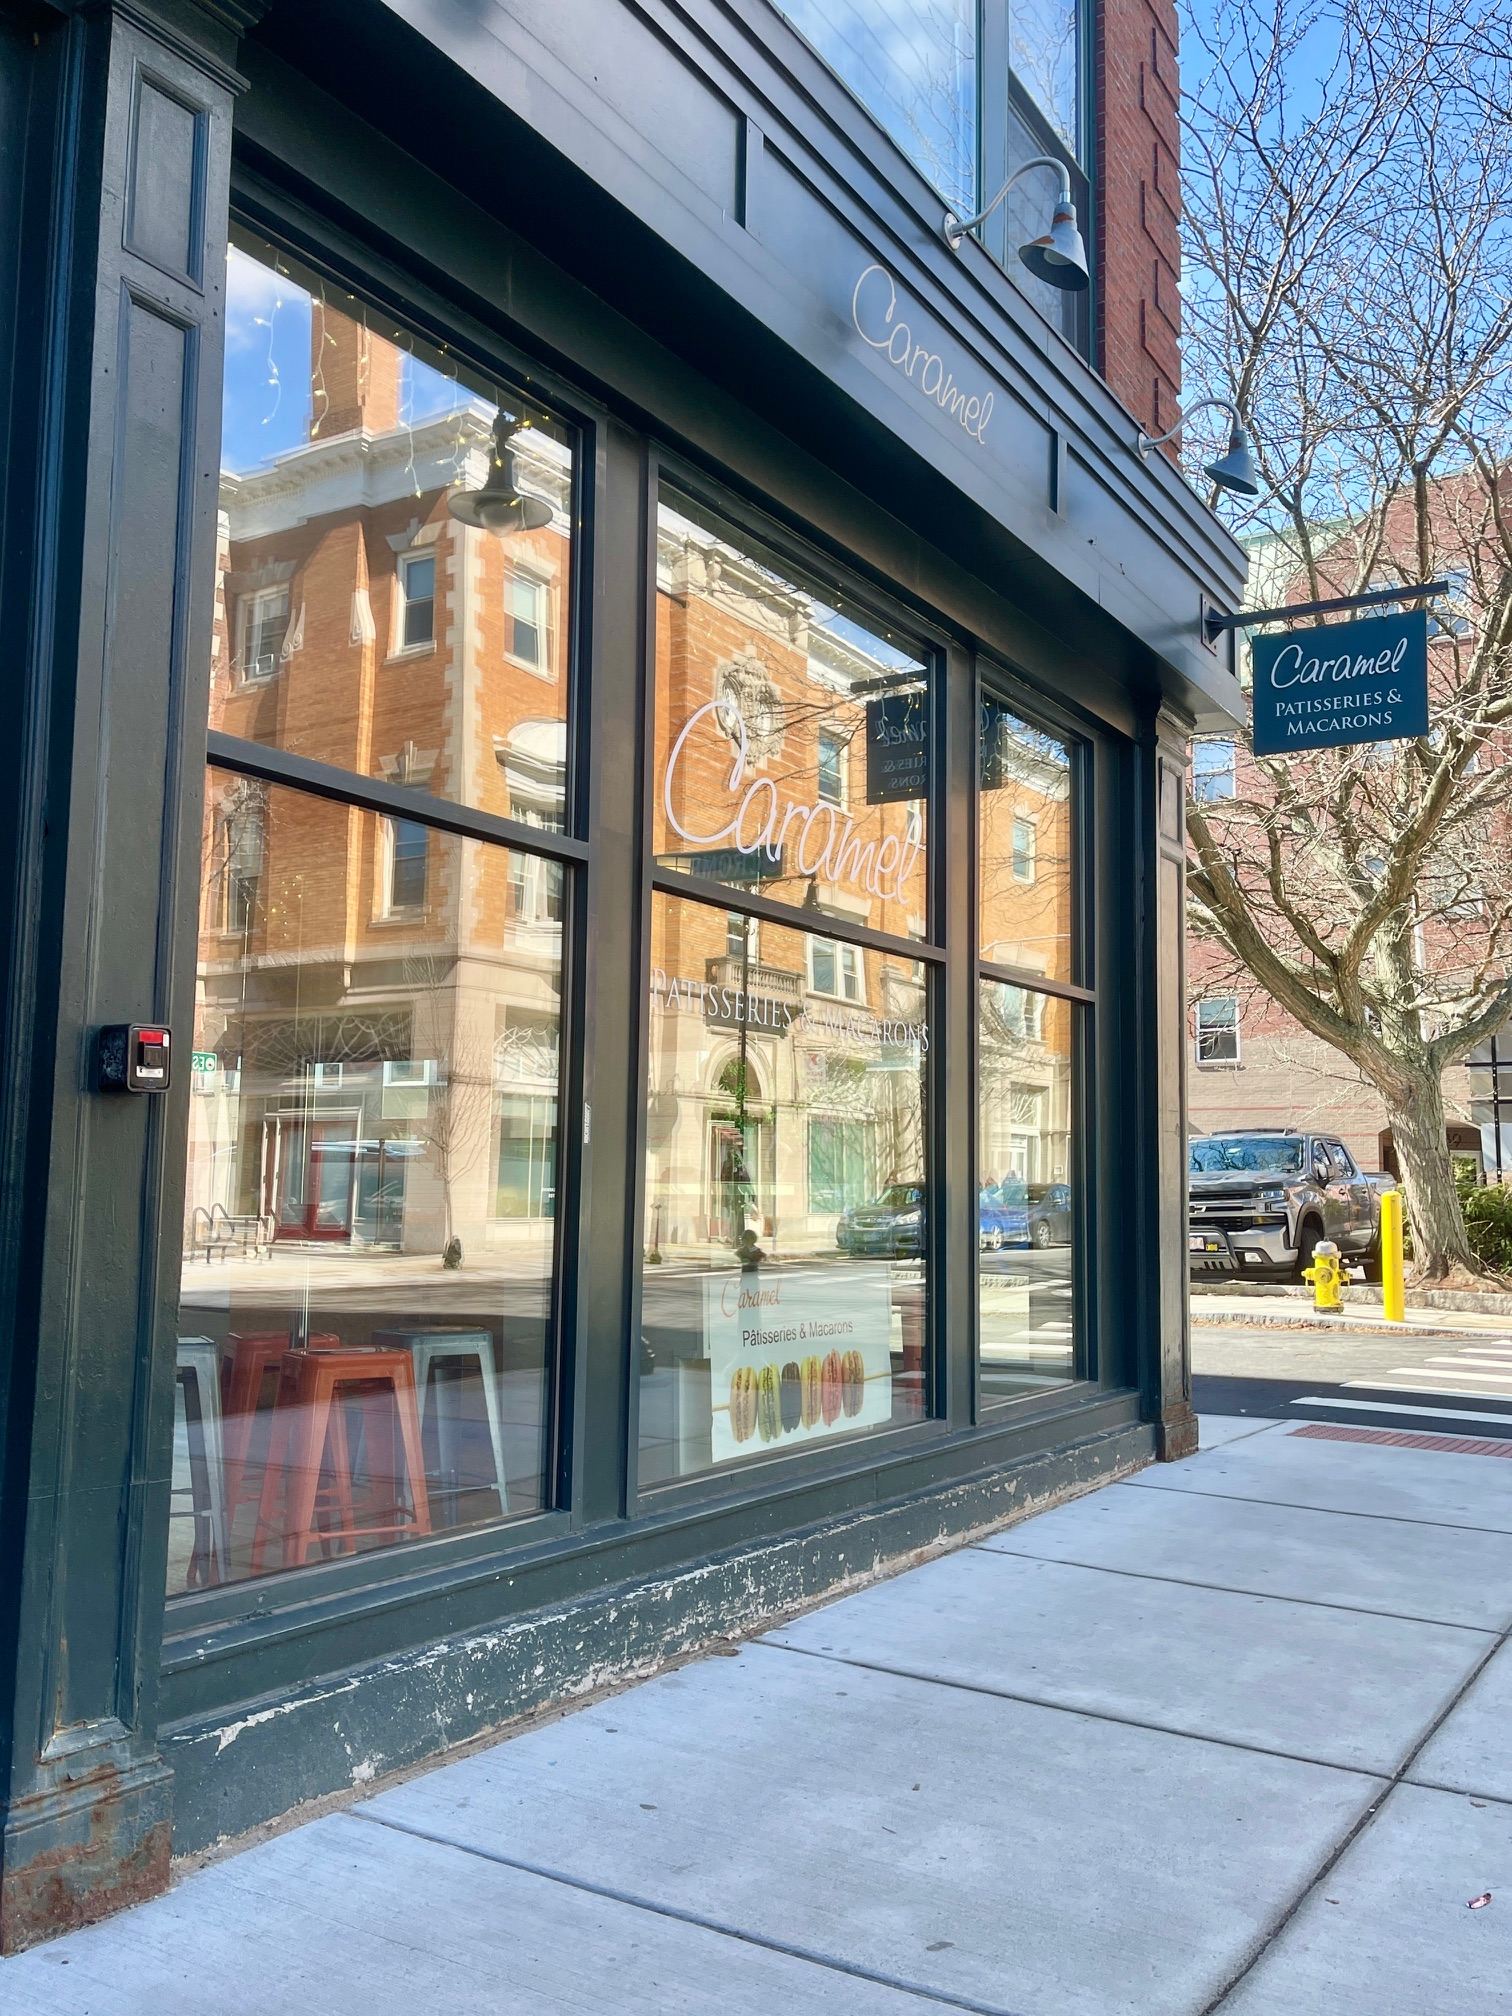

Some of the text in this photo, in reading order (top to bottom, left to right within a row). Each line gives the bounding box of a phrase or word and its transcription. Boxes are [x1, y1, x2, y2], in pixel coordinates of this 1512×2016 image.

[853, 264, 994, 445] Caramel
[1270, 637, 1408, 689] Caramel
[1275, 688, 1403, 717] PATISSERIES &
[1286, 710, 1393, 736] MACARONS
[665, 701, 923, 905] Caramel
[651, 967, 930, 1052] PATISSERIES & MACARONS
[720, 1274, 784, 1318] Caramel
[742, 1320, 854, 1347] Pâtisseries & Macarons
